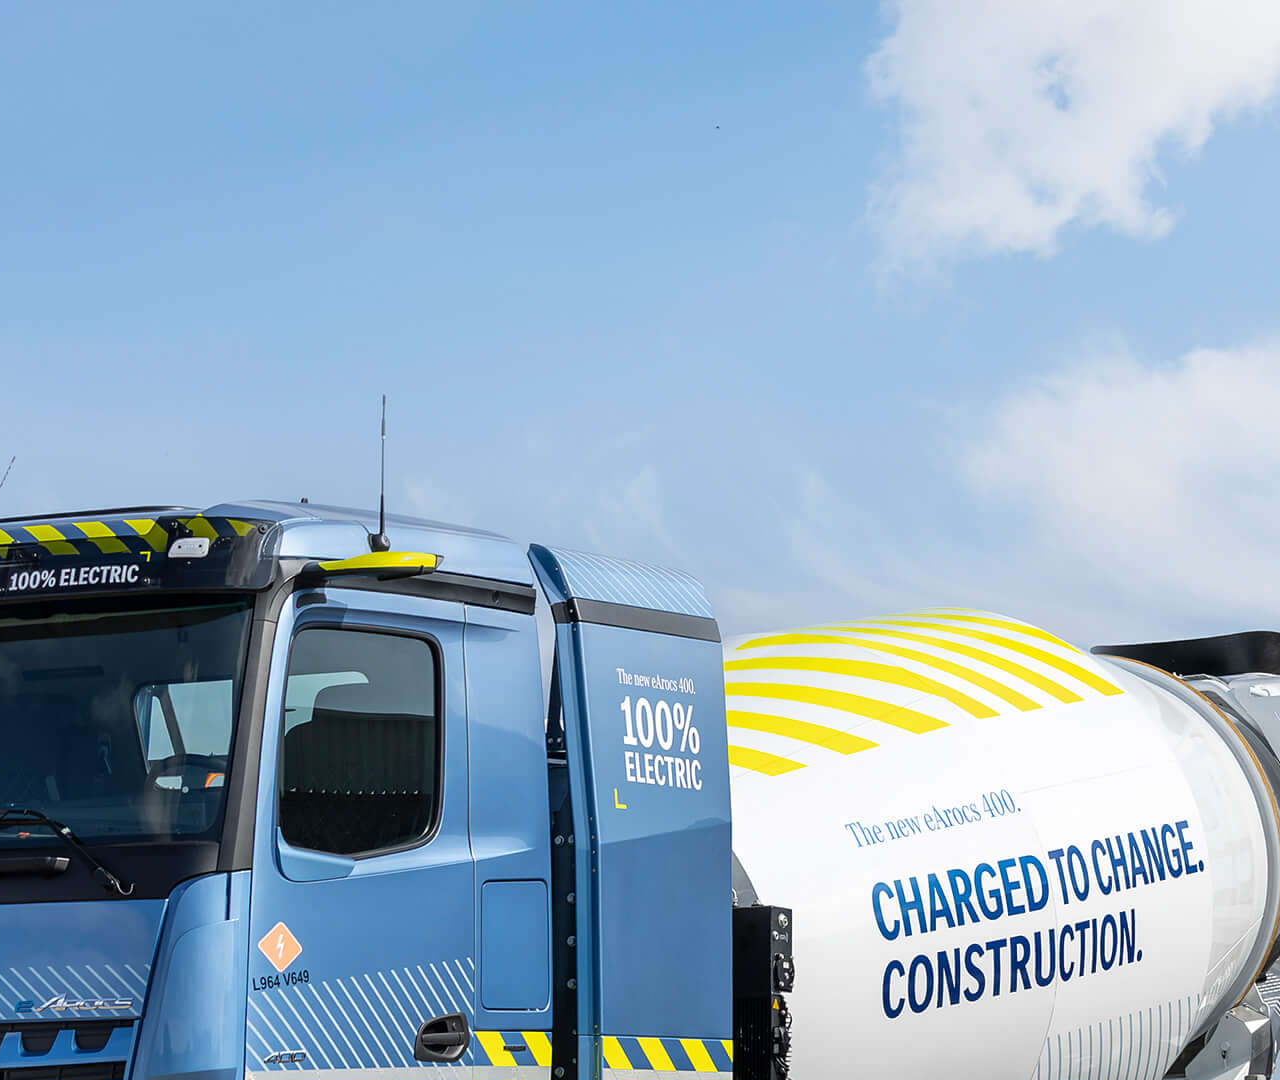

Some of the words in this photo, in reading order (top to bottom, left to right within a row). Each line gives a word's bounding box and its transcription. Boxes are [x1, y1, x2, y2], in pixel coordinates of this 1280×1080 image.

[8, 568, 57, 592] 100%
[59, 564, 140, 587] ELECTRIC
[616, 667, 633, 686] The
[634, 673, 650, 688] new
[651, 674, 679, 692] eArocs
[678, 677, 697, 695] 400.
[620, 695, 701, 755] 100%
[624, 751, 703, 791] ELECTRIC
[845, 821, 885, 849] The
[885, 814, 921, 842] new
[923, 804, 982, 833] eArocs
[981, 788, 1021, 819] 400.
[871, 854, 1050, 942] CHARGED
[1047, 844, 1091, 906] TO
[1090, 820, 1205, 896] CHANGE.
[252, 974, 281, 992] L964
[282, 969, 310, 987] V649
[881, 908, 1143, 1020] CONSTRUCTION.
